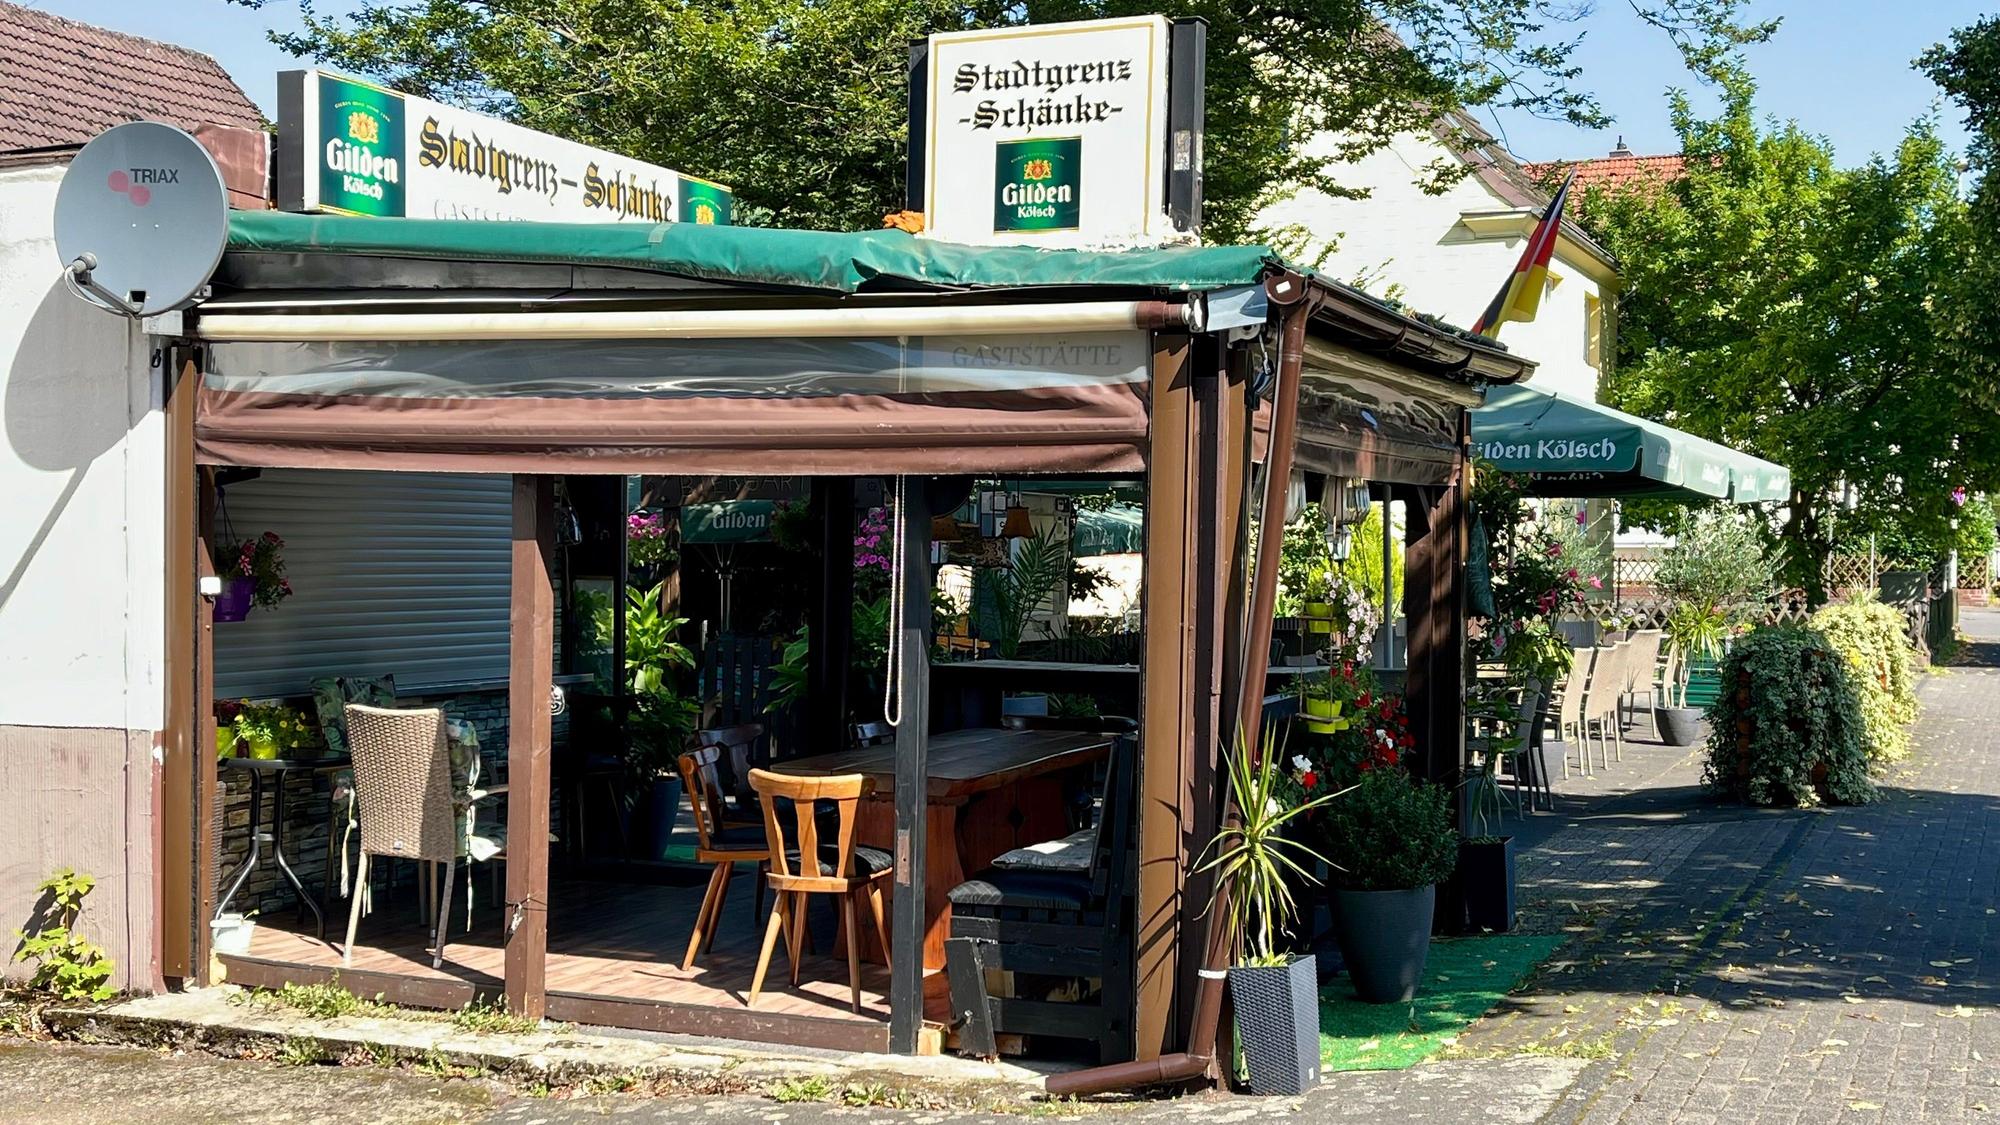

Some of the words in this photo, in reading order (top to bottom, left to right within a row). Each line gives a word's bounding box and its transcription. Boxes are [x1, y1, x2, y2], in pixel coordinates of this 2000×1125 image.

[953, 58, 1132, 93] Stadtgrenz
[326, 137, 398, 184] Gilden
[130, 168, 179, 184] TRIAX
[343, 175, 383, 200] Kölsch
[1002, 182, 1072, 206] Gilden
[1017, 205, 1056, 218] Kölsch
[953, 341, 1121, 367] GASTSTÄTTE
[1469, 441, 1531, 459] ilden
[1537, 438, 1616, 461] Kölsch
[712, 511, 766, 529] Gilden
